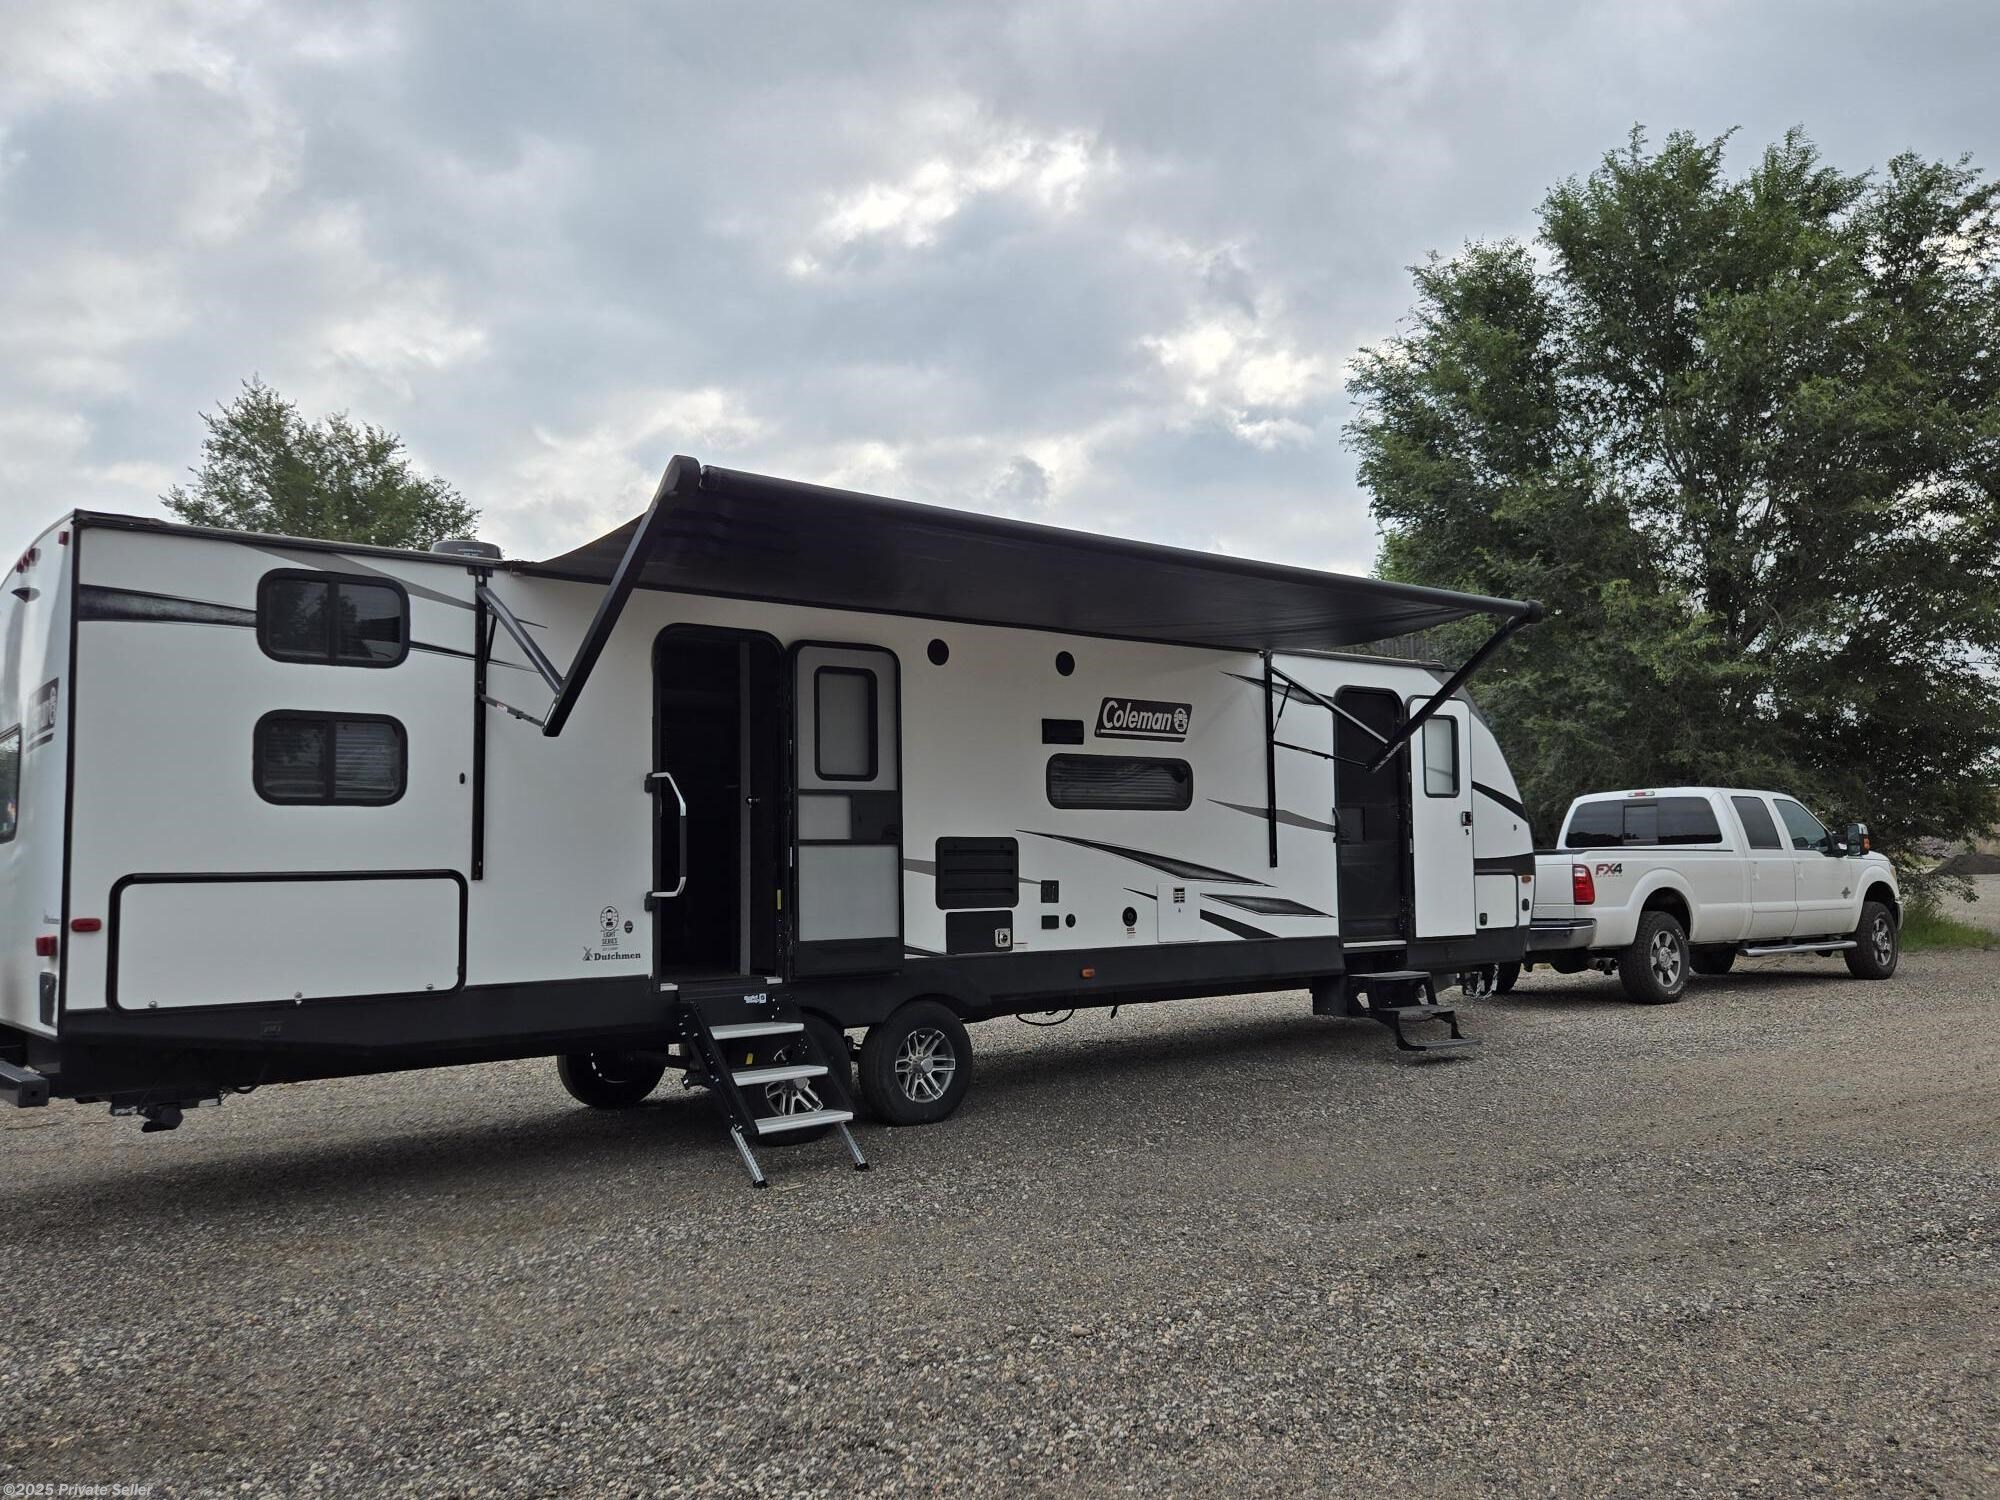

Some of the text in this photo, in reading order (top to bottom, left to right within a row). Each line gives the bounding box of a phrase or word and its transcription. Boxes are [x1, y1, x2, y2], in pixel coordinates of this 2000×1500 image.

[1102, 700, 1173, 731] Coleman
[1595, 863, 1623, 875] FX4
[594, 952, 641, 961] Dutchmen
